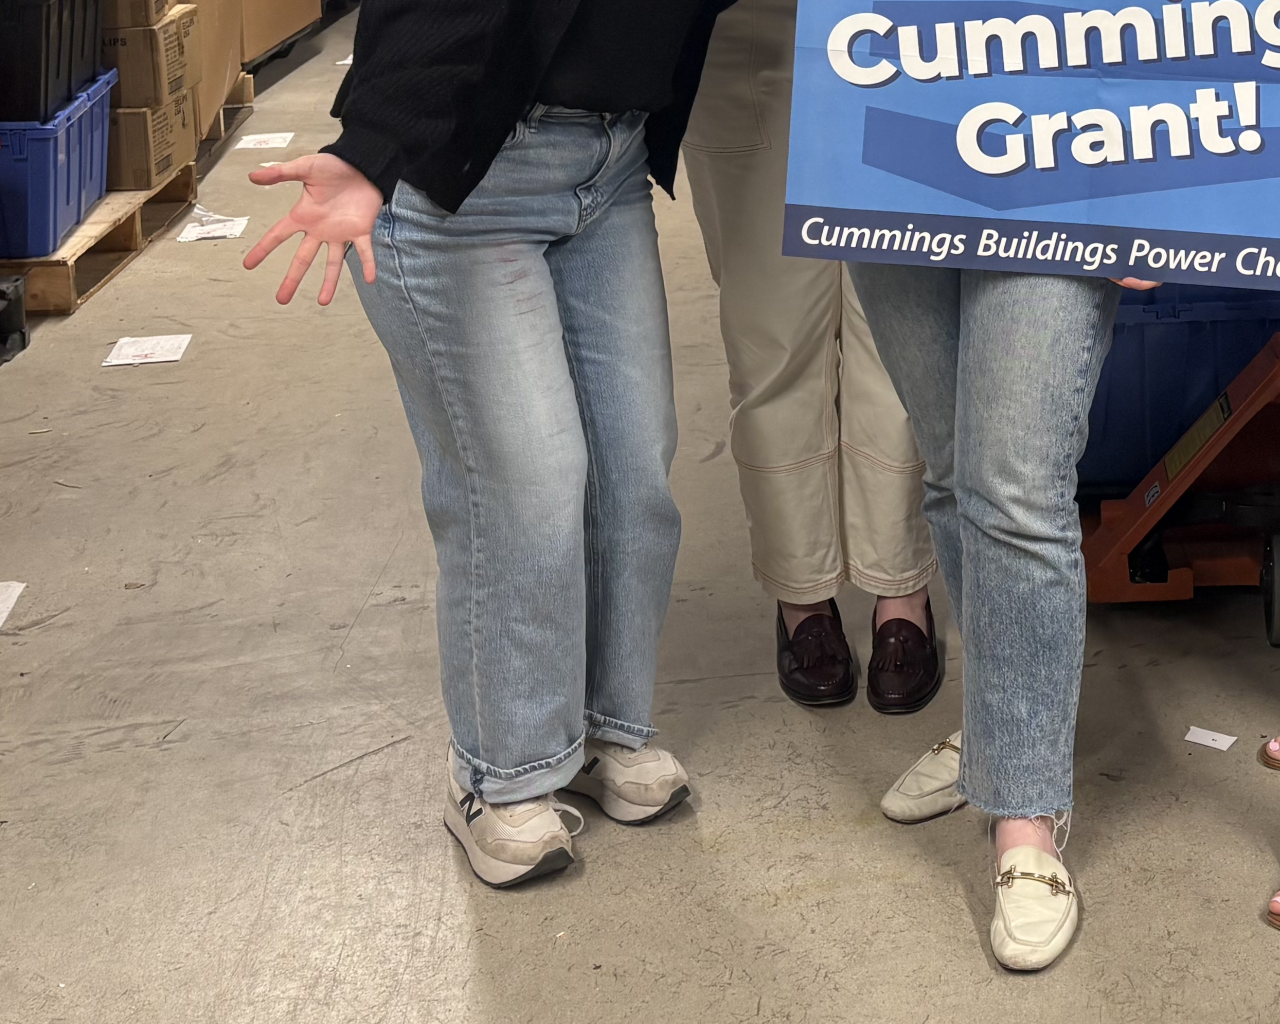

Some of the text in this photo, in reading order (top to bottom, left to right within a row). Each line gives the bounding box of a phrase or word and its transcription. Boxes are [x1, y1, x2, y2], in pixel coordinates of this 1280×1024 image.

[956, 80, 1264, 176] Grant!
[800, 217, 966, 262] Cummings
[978, 228, 1118, 270] Buildings
[1129, 238, 1226, 274] Power
